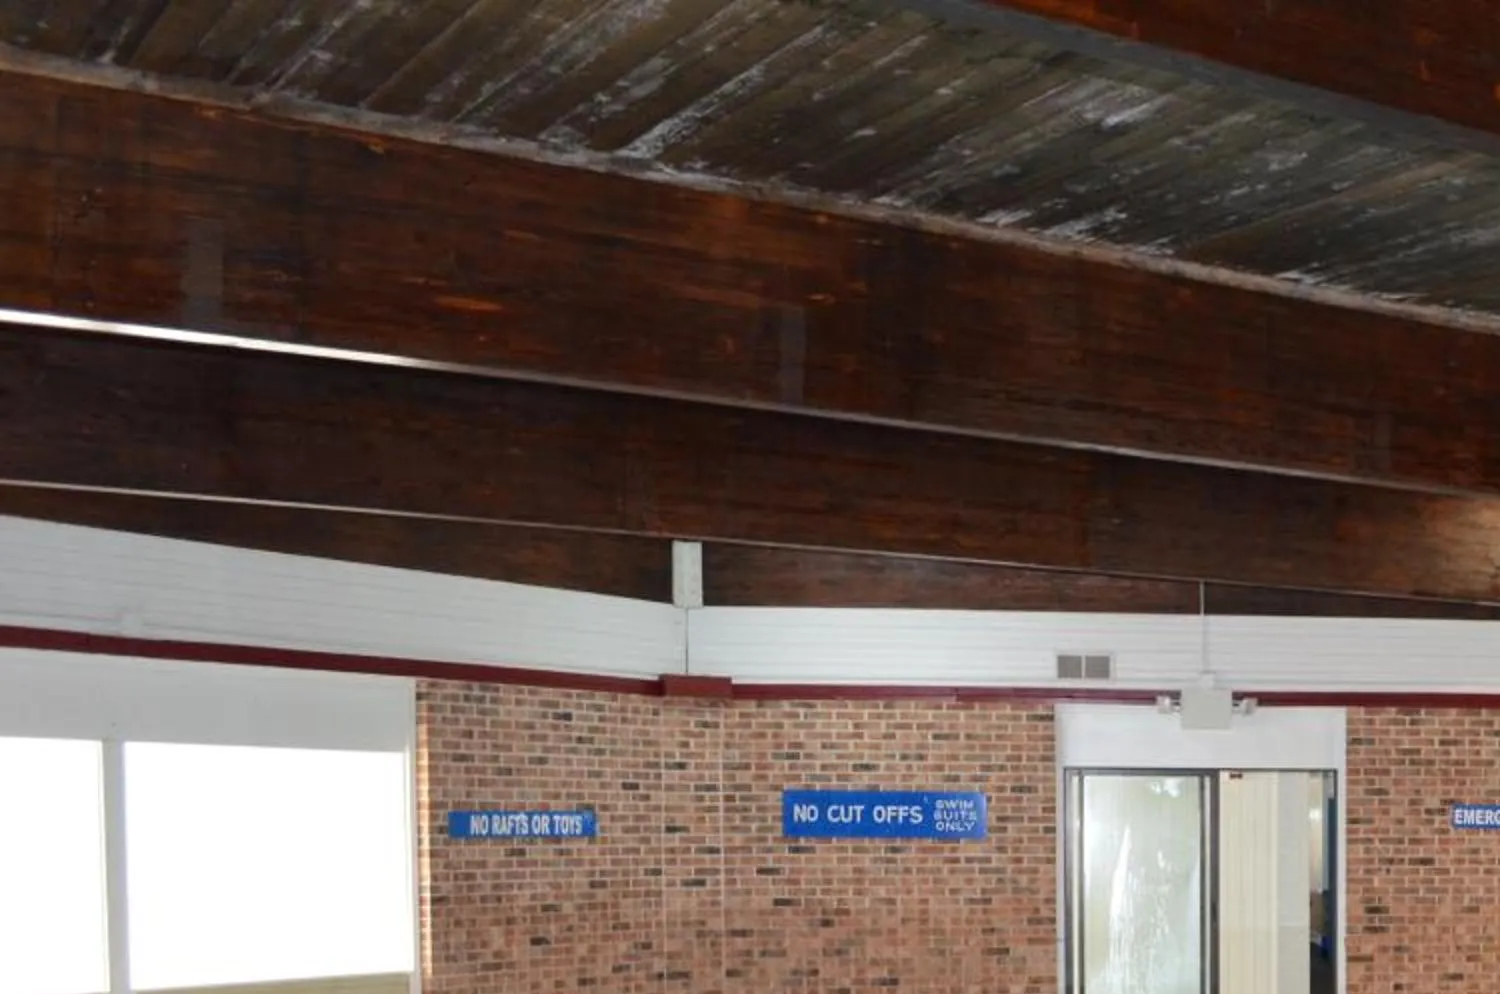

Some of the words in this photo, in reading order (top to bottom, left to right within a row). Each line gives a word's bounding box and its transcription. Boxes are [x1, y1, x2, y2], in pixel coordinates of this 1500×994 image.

[935, 799, 973, 809] SWIM
[793, 804, 818, 822] NO
[827, 805, 864, 823] CUT
[873, 805, 923, 824] OFFS
[933, 809, 977, 822] SUITS
[470, 814, 489, 835] NO
[492, 813, 528, 835] RAFTS
[531, 814, 550, 835] OR
[552, 814, 582, 835] TOYS
[935, 821, 975, 832] ONLY
